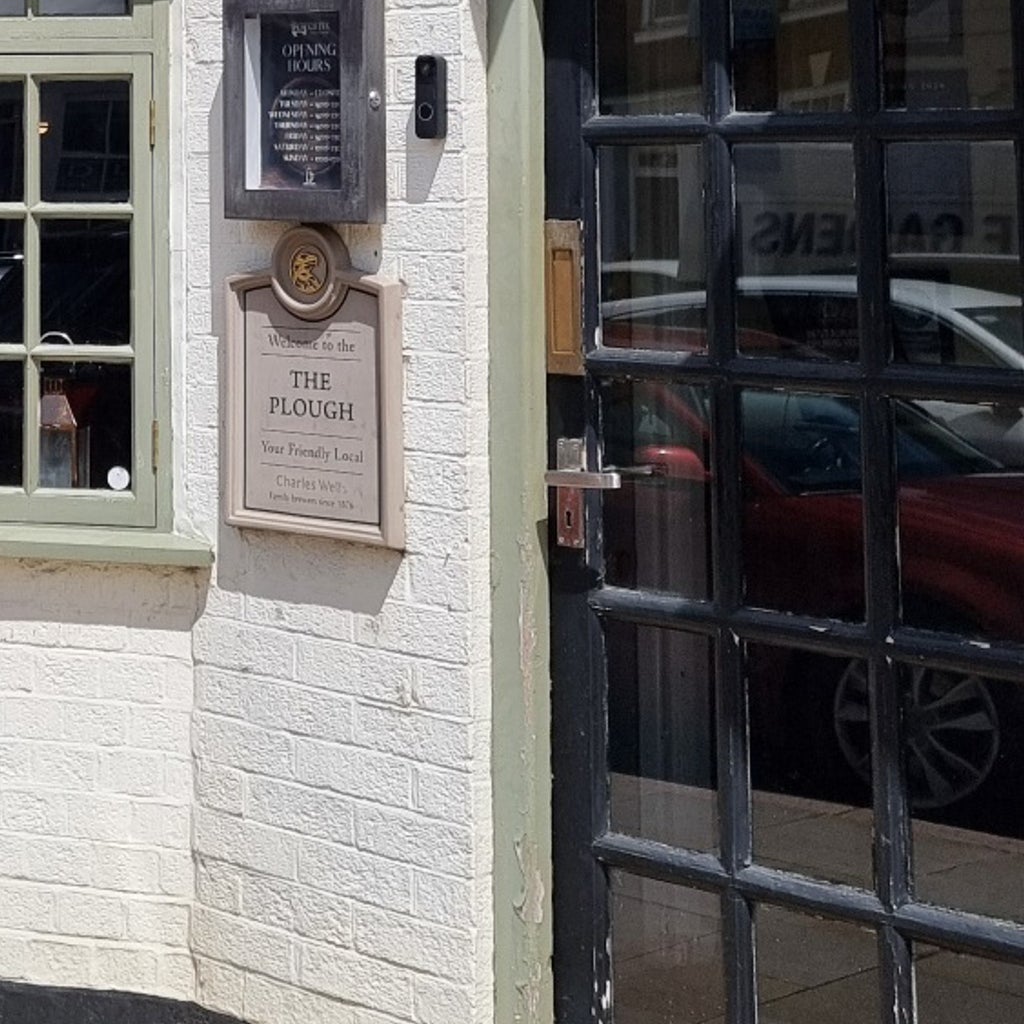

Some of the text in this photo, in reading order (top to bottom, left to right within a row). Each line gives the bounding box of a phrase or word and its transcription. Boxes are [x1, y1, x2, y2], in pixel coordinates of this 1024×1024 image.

[282, 43, 336, 58] OPENING
[288, 59, 331, 72] HOURS
[267, 333, 355, 353] Welcome to the
[289, 369, 332, 391] THE
[268, 396, 355, 422] PLOUGH
[261, 440, 364, 464] Your Friendly Local
[276, 474, 316, 491] Charles
